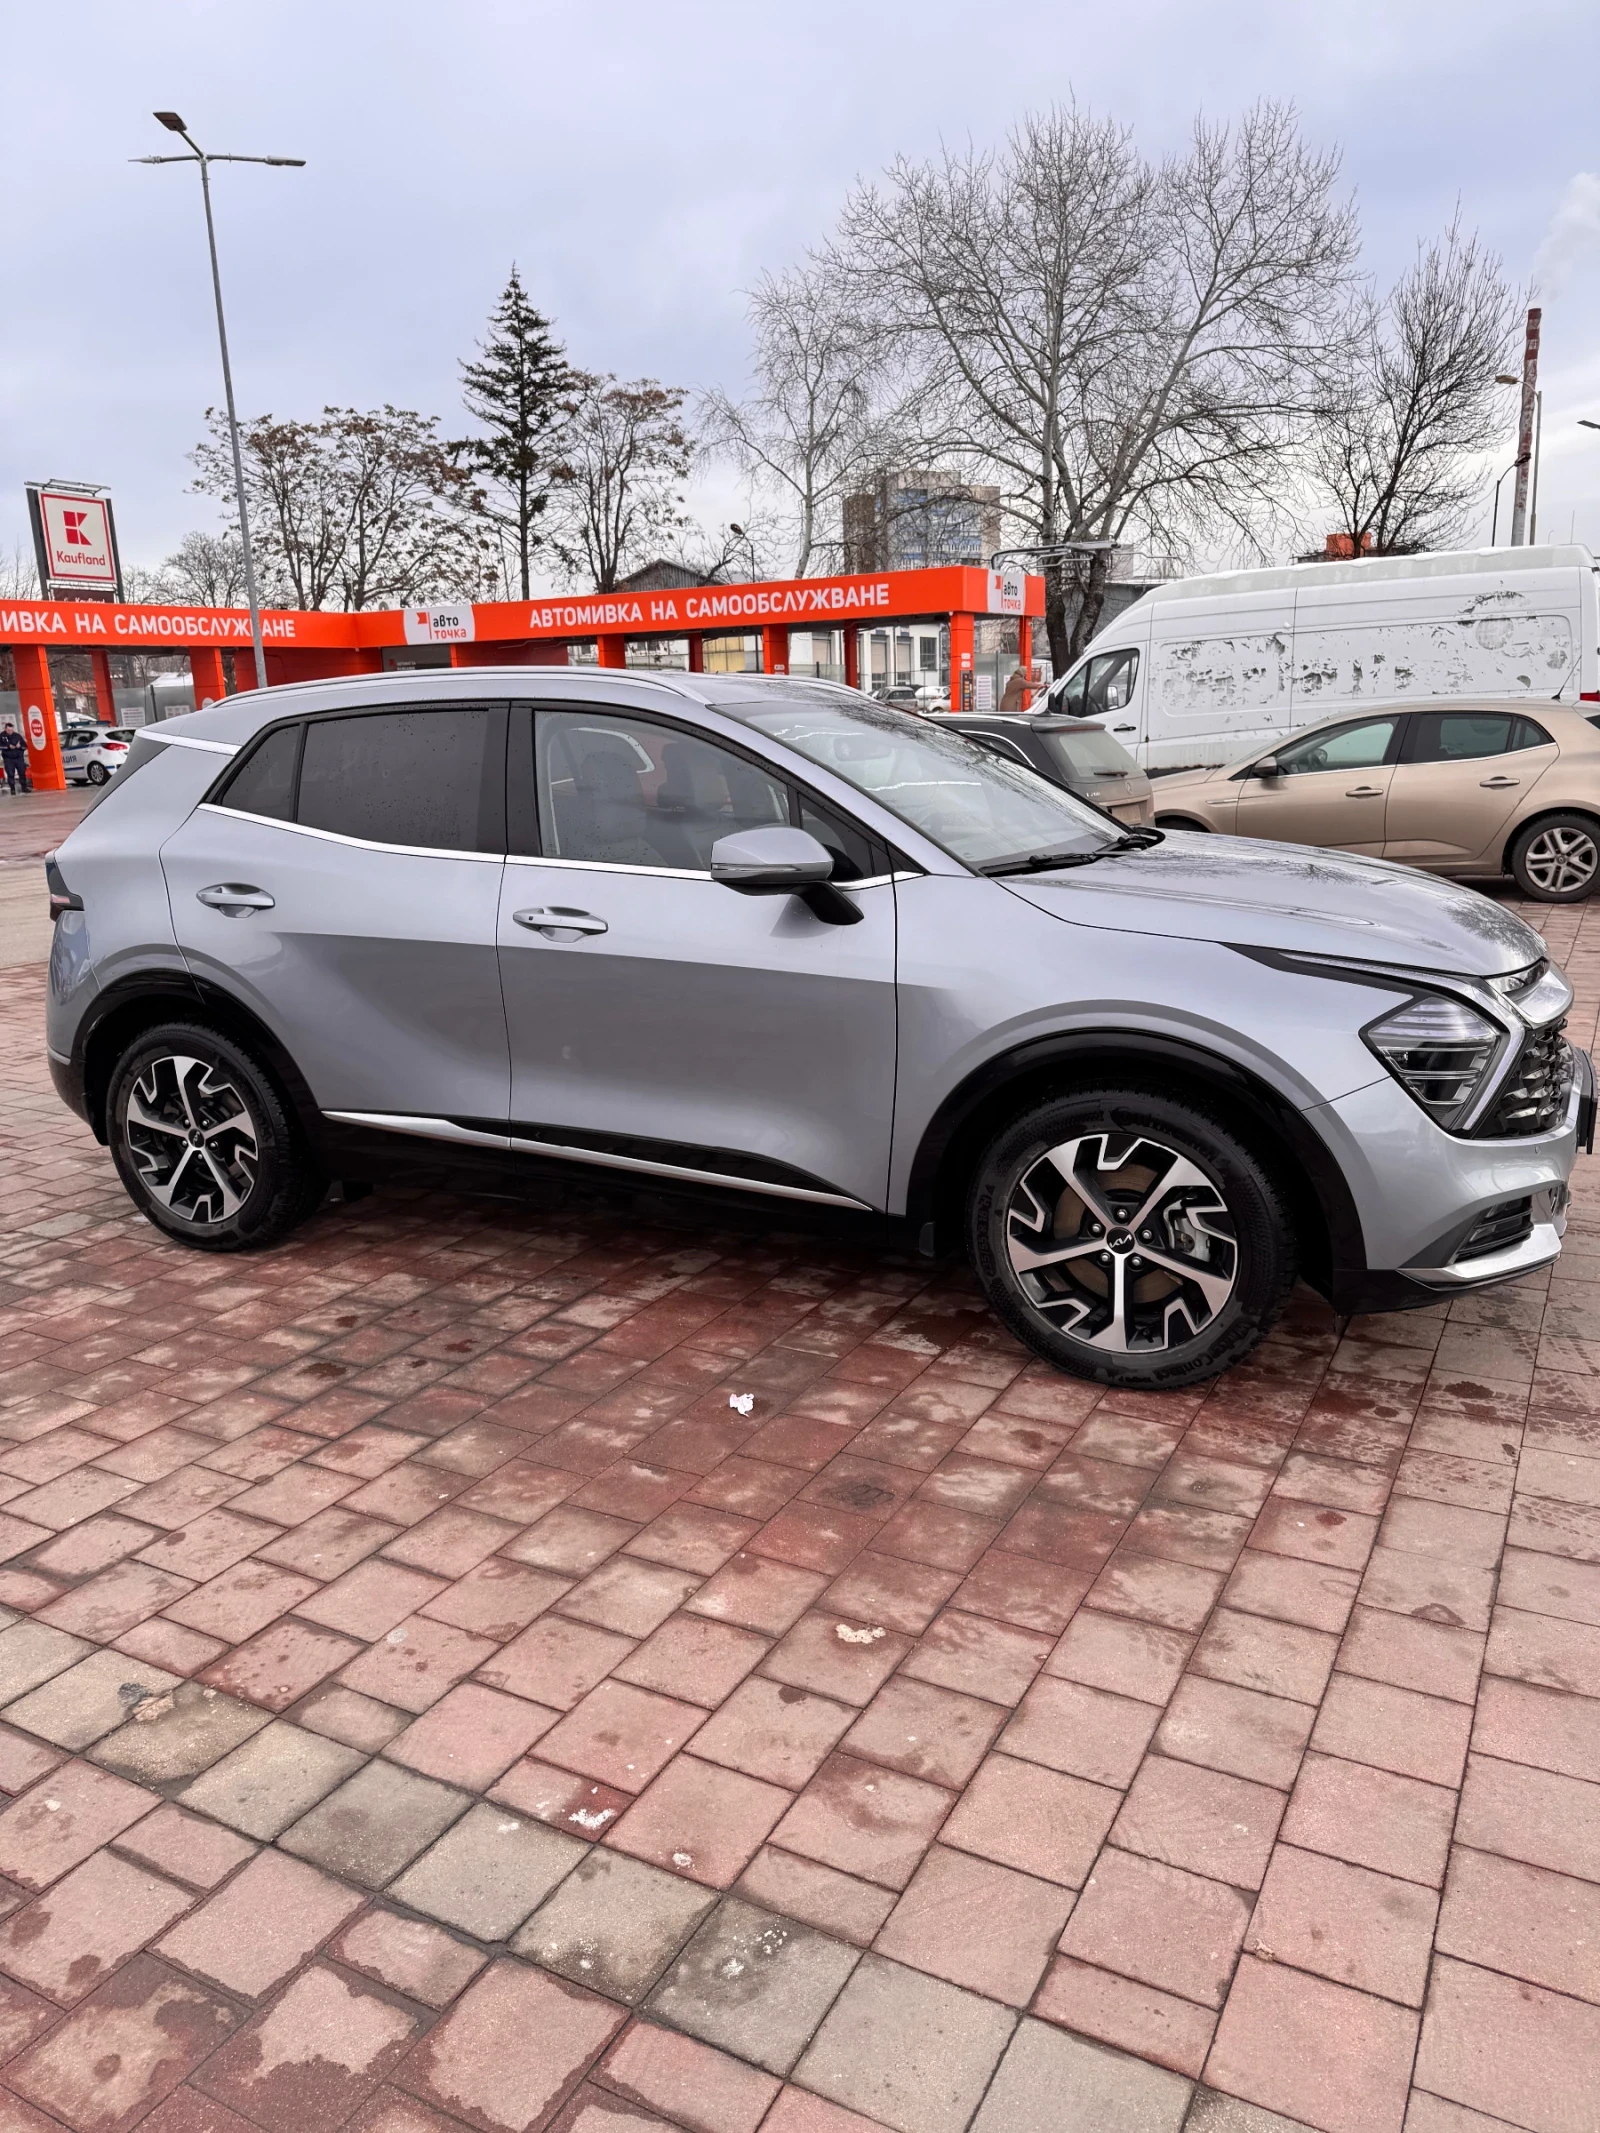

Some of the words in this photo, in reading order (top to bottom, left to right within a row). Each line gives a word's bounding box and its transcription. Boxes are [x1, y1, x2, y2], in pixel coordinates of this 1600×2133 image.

[57, 550, 106, 566] Kaufland
[1004, 581, 1018, 596] авто
[529, 602, 643, 629] АВТОМИВКА
[651, 600, 678, 620] НА
[686, 583, 890, 618] САМООБСЛУЖВАНЕ
[74, 612, 107, 634] НА
[113, 613, 296, 638] САМООБСЛУЖАНЕ
[432, 614, 459, 627] авто
[434, 628, 467, 640] точка
